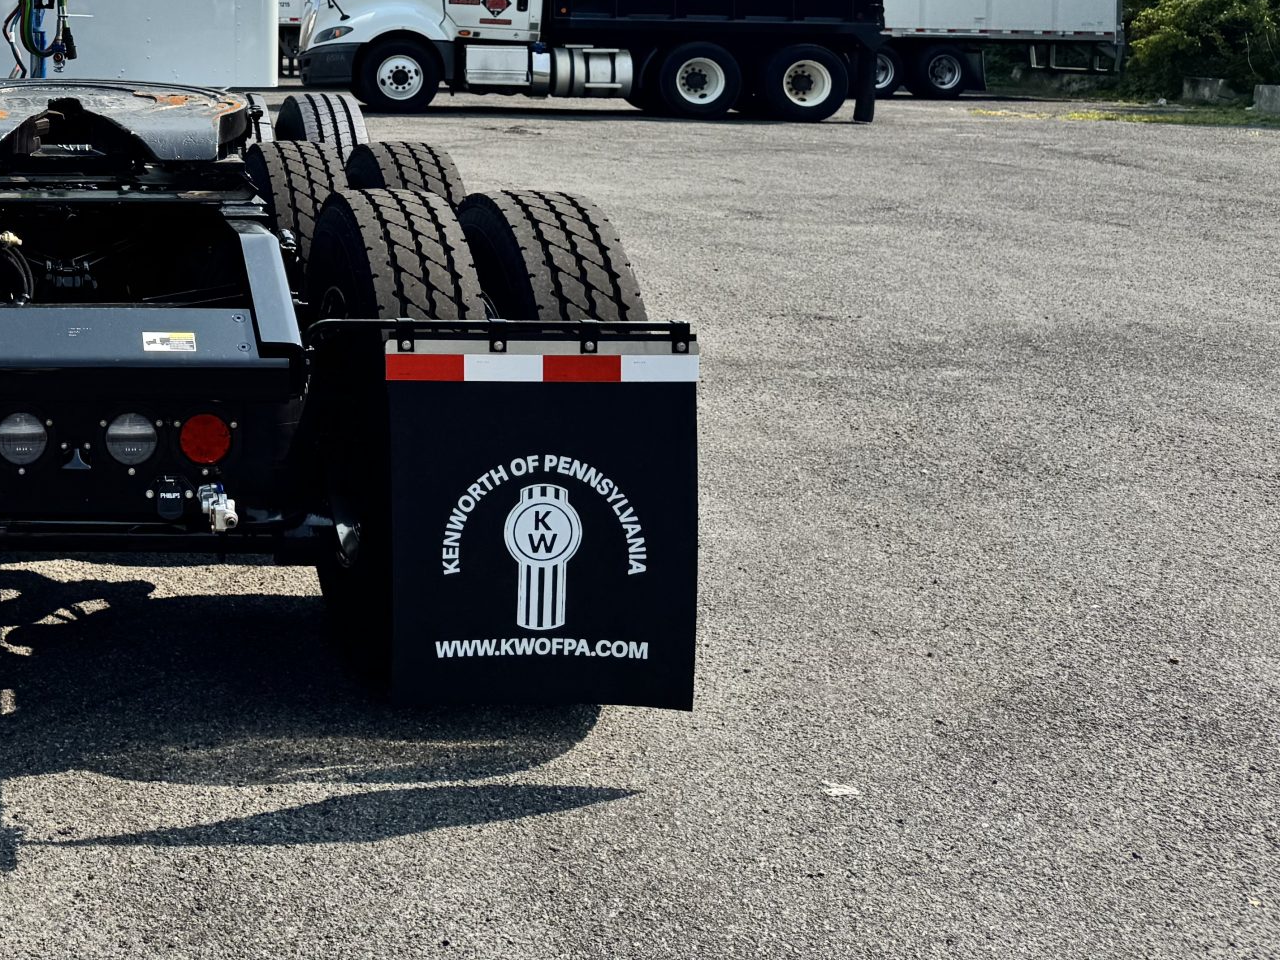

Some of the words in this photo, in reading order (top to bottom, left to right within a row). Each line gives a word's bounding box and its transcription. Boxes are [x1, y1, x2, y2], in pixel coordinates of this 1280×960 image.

[442, 464, 509, 575] KENWORTH
[510, 454, 539, 477] OF
[543, 454, 647, 575] PENNSYLVANIA
[533, 510, 553, 531] K
[527, 533, 558, 554] W
[435, 637, 649, 660] WWW.KWOFPA.COM
